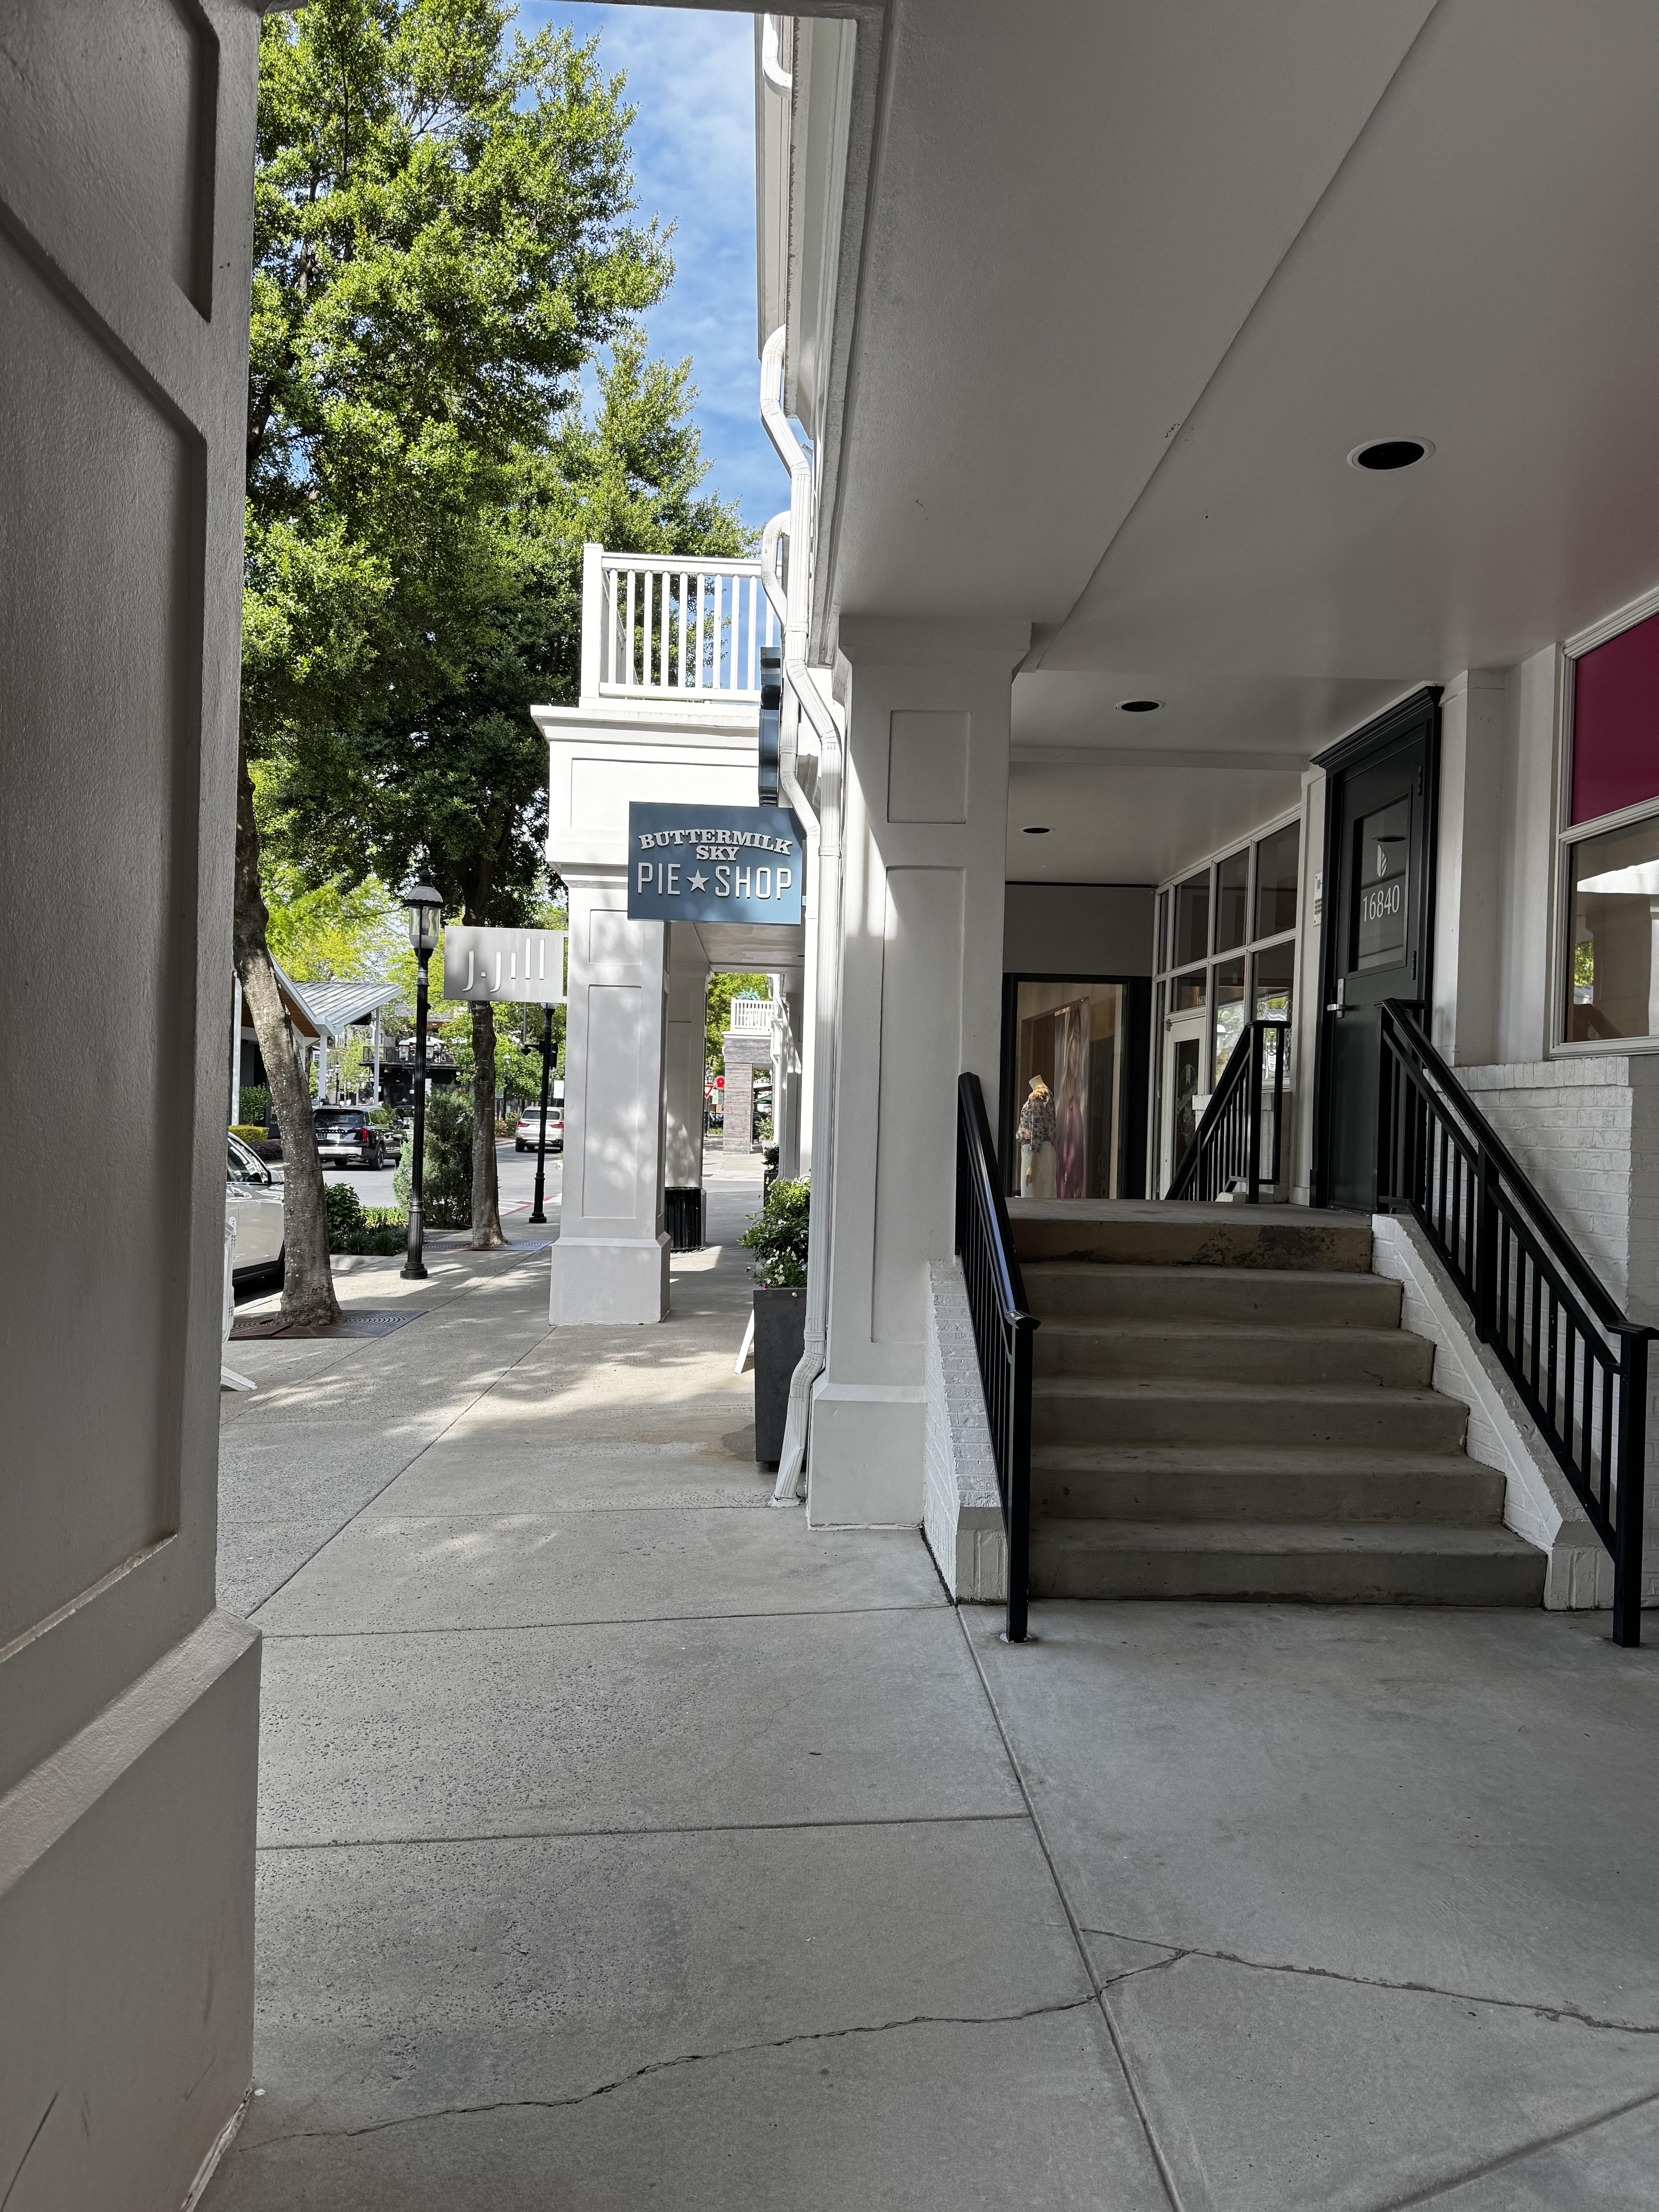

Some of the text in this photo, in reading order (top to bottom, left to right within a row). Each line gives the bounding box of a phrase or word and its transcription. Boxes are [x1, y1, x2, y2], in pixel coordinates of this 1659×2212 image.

[638, 829, 793, 855] BUTTERMILK
[696, 845, 739, 860] SKY
[638, 862, 792, 900] PIE SHOP
[1362, 884, 1400, 922] 16840
